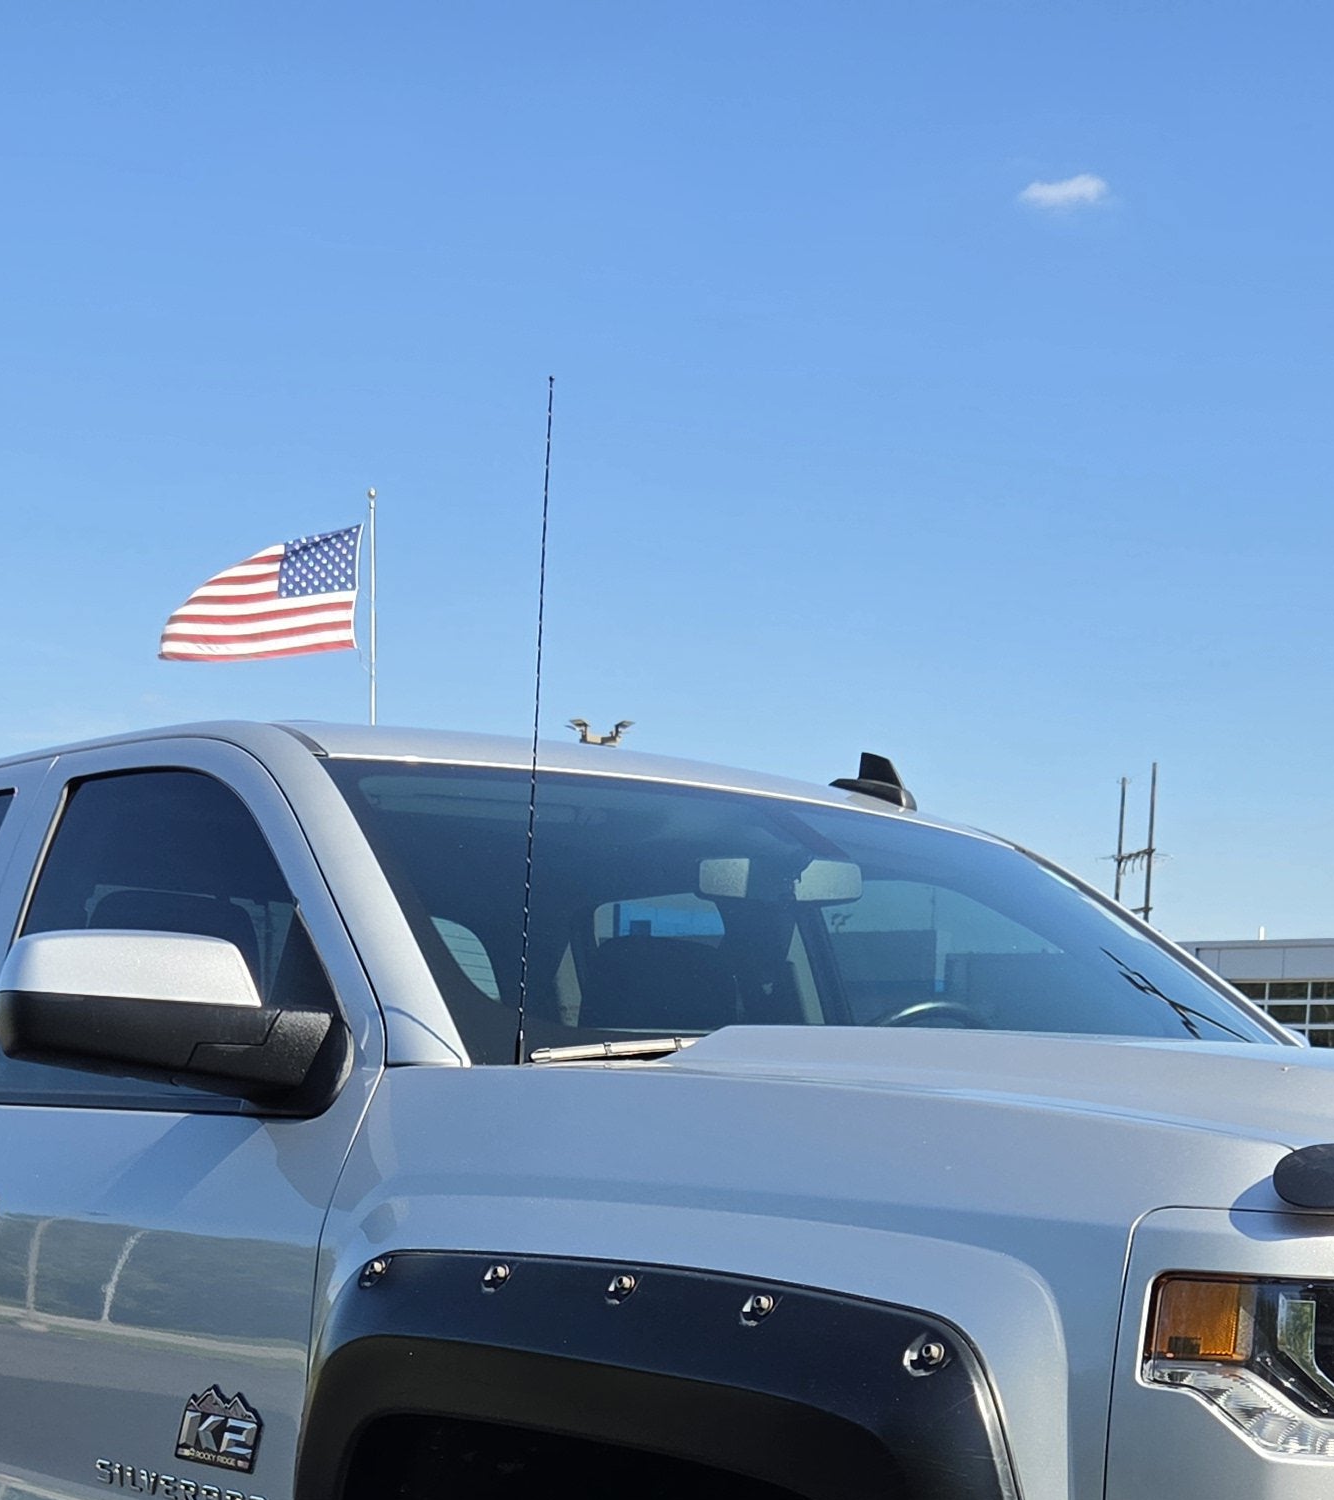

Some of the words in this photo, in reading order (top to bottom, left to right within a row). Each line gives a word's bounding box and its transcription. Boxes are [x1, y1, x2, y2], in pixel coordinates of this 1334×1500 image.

[179, 1411, 258, 1459] K2
[194, 1450, 216, 1462] ROCKY
[216, 1455, 236, 1466] RIDGE
